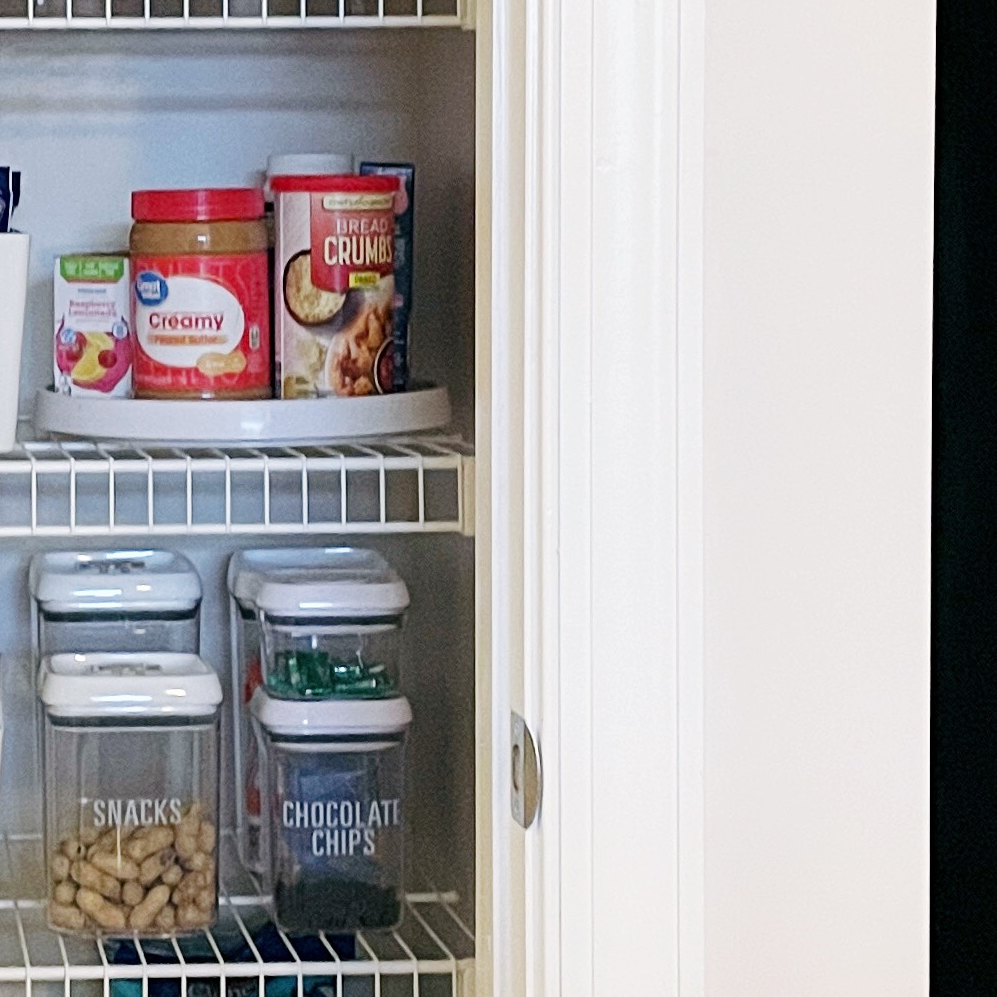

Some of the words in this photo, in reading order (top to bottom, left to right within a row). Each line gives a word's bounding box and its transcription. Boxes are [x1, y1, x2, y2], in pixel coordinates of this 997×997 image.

[336, 217, 388, 234] BREAD
[324, 235, 392, 265] CRUMBS
[149, 312, 224, 331] Creamy
[93, 798, 182, 827] SNACKS
[282, 799, 401, 829] CHOCOLATE
[312, 829, 375, 856] CHIPS
